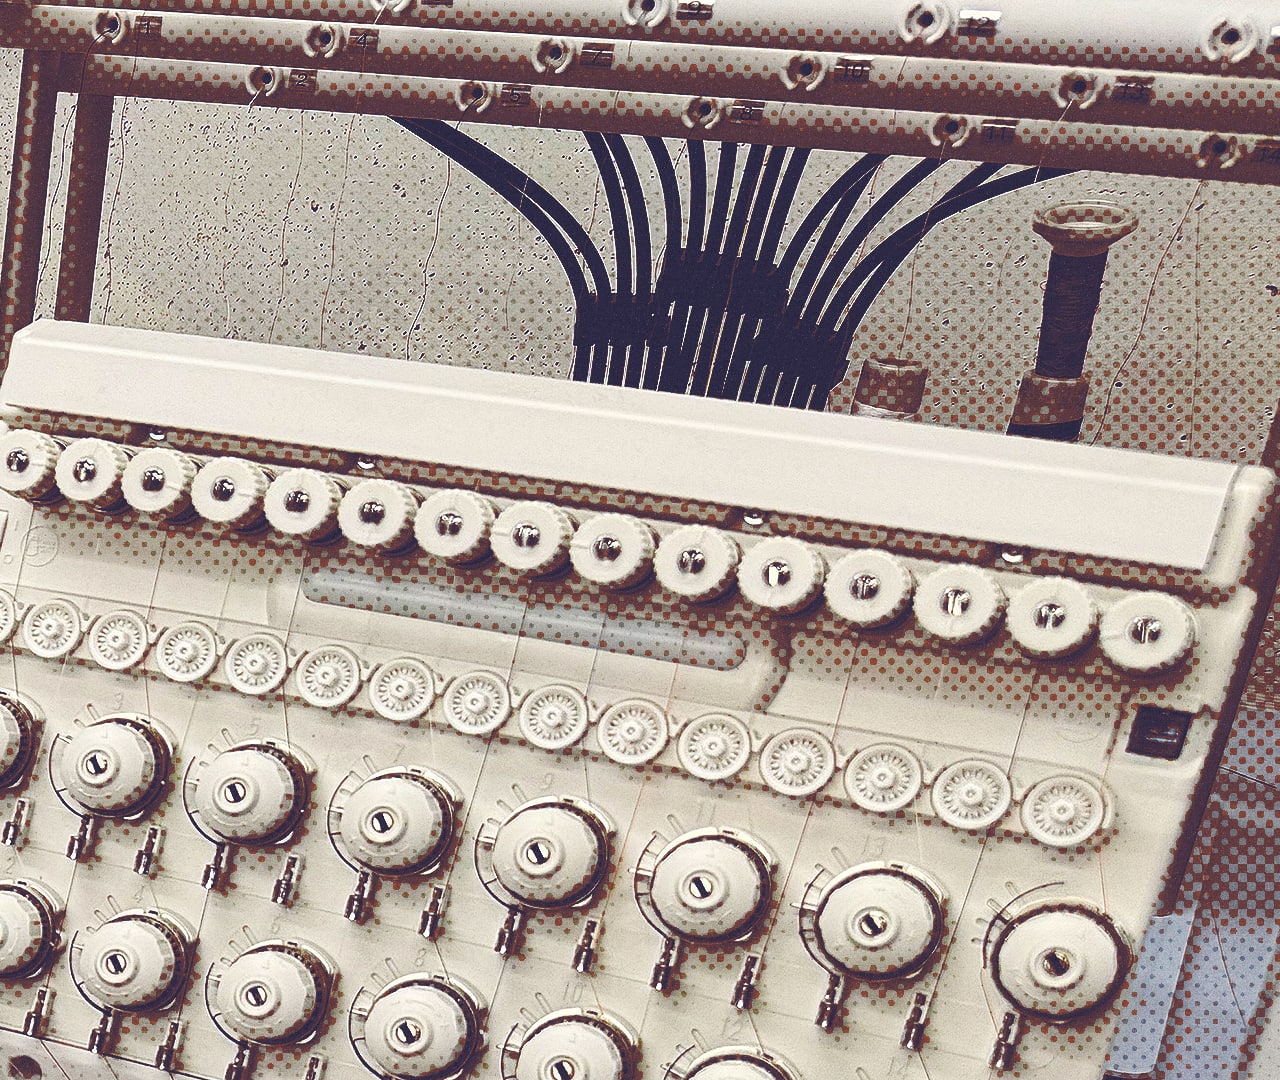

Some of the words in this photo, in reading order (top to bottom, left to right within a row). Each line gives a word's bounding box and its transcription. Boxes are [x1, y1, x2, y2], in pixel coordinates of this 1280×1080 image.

[356, 34, 369, 48] 4
[295, 73, 306, 86] 2
[509, 88, 521, 101] 5
